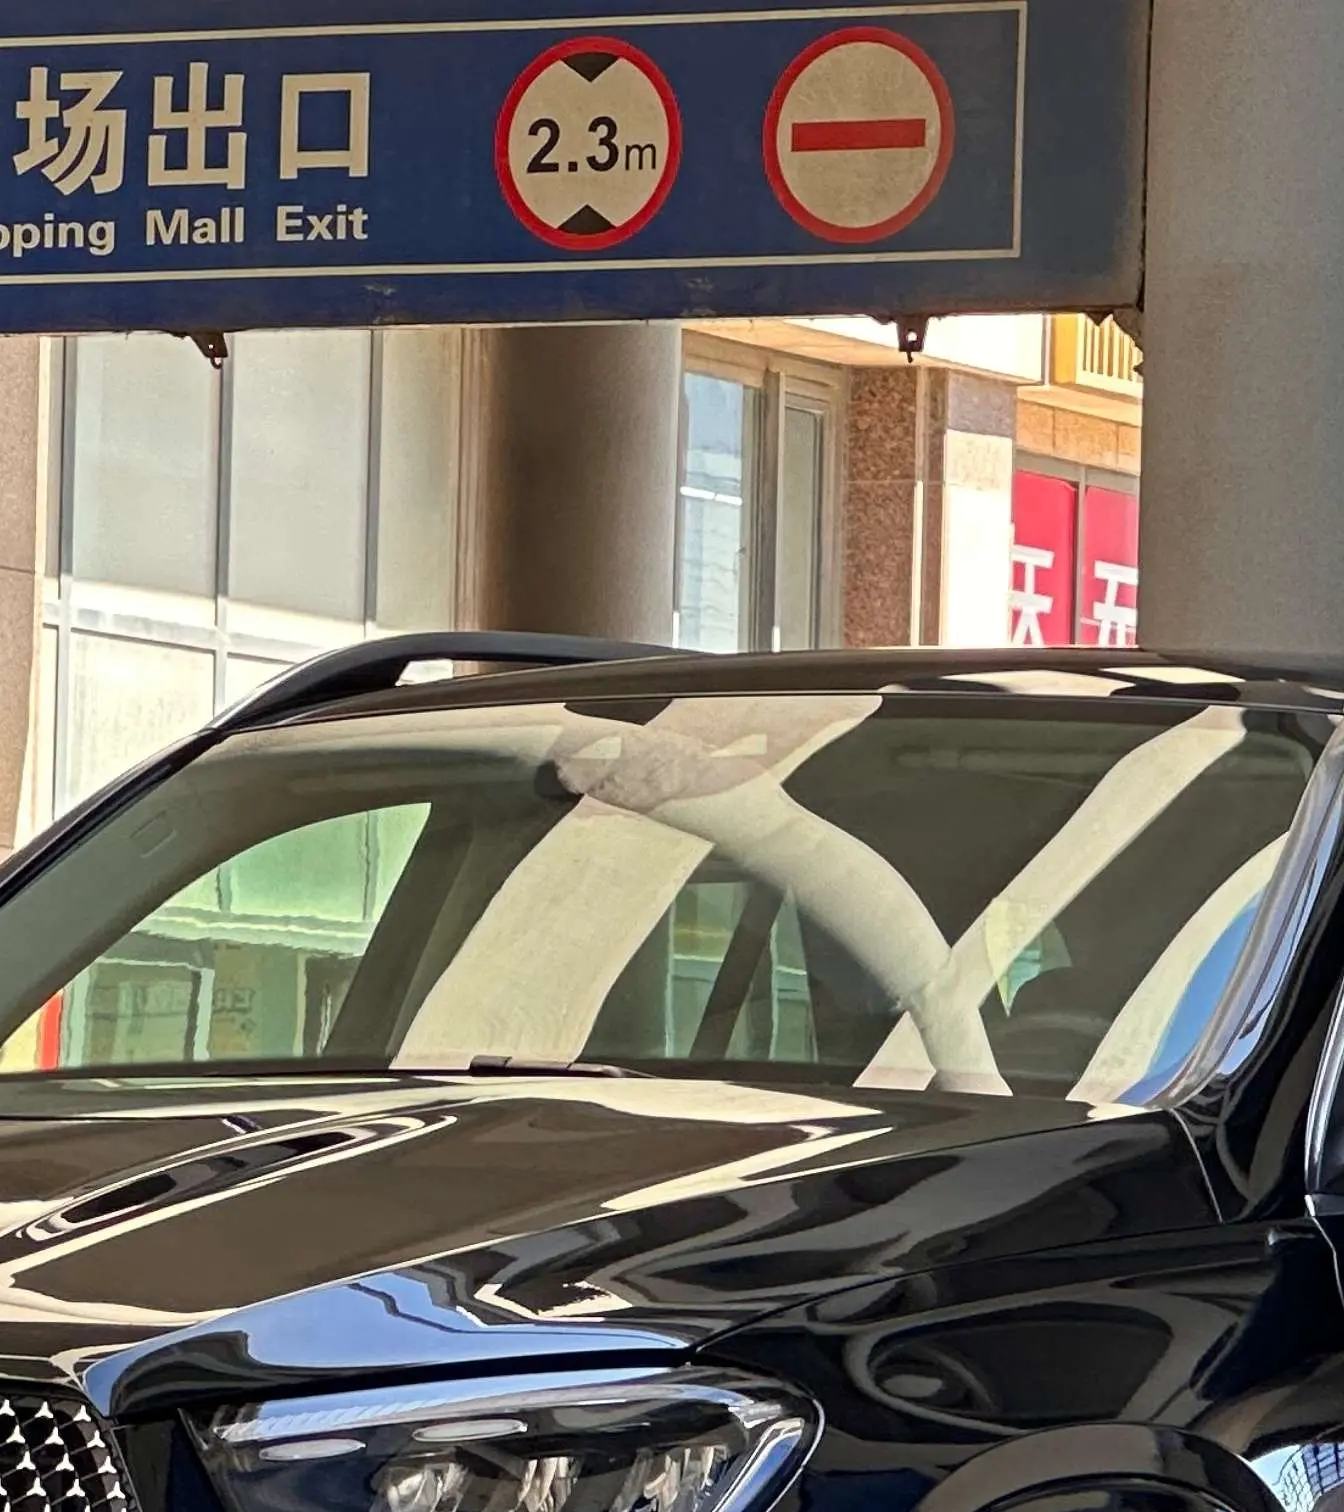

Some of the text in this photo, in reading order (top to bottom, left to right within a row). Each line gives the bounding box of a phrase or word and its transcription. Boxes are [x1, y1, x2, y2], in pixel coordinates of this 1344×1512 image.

[526, 115, 657, 174] 2.3m
[145, 205, 245, 246] Mall
[276, 203, 369, 242] Exit
